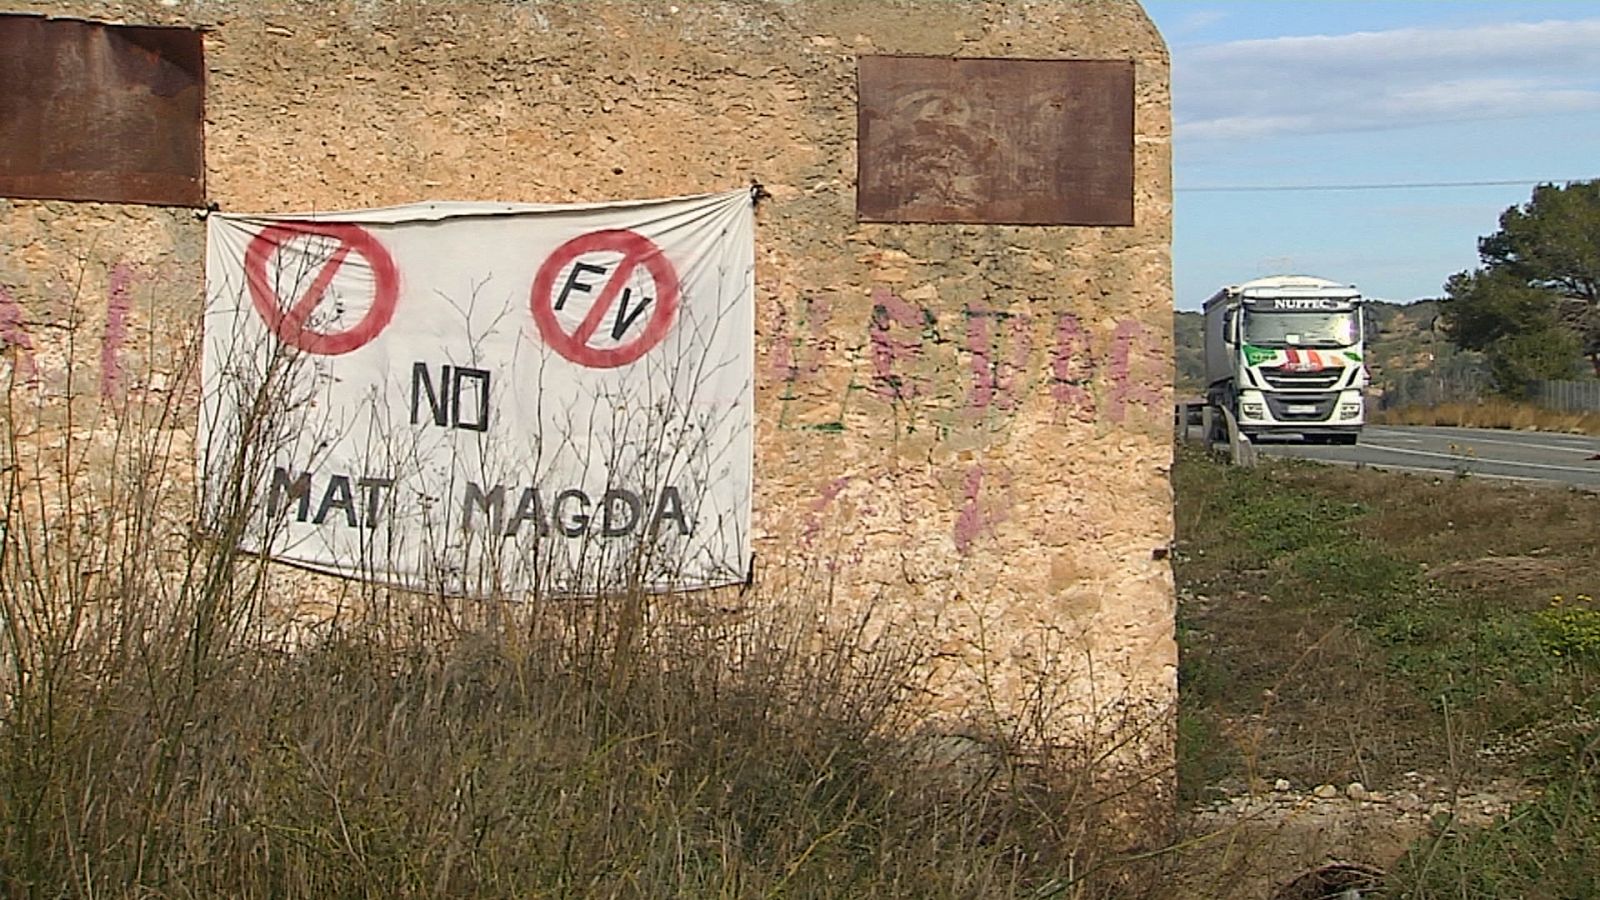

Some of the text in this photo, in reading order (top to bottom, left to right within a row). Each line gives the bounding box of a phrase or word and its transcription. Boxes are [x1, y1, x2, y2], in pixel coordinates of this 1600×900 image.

[555, 261, 654, 340] F V
[410, 361, 491, 433] NO
[266, 465, 690, 538] MAT MAGDA
